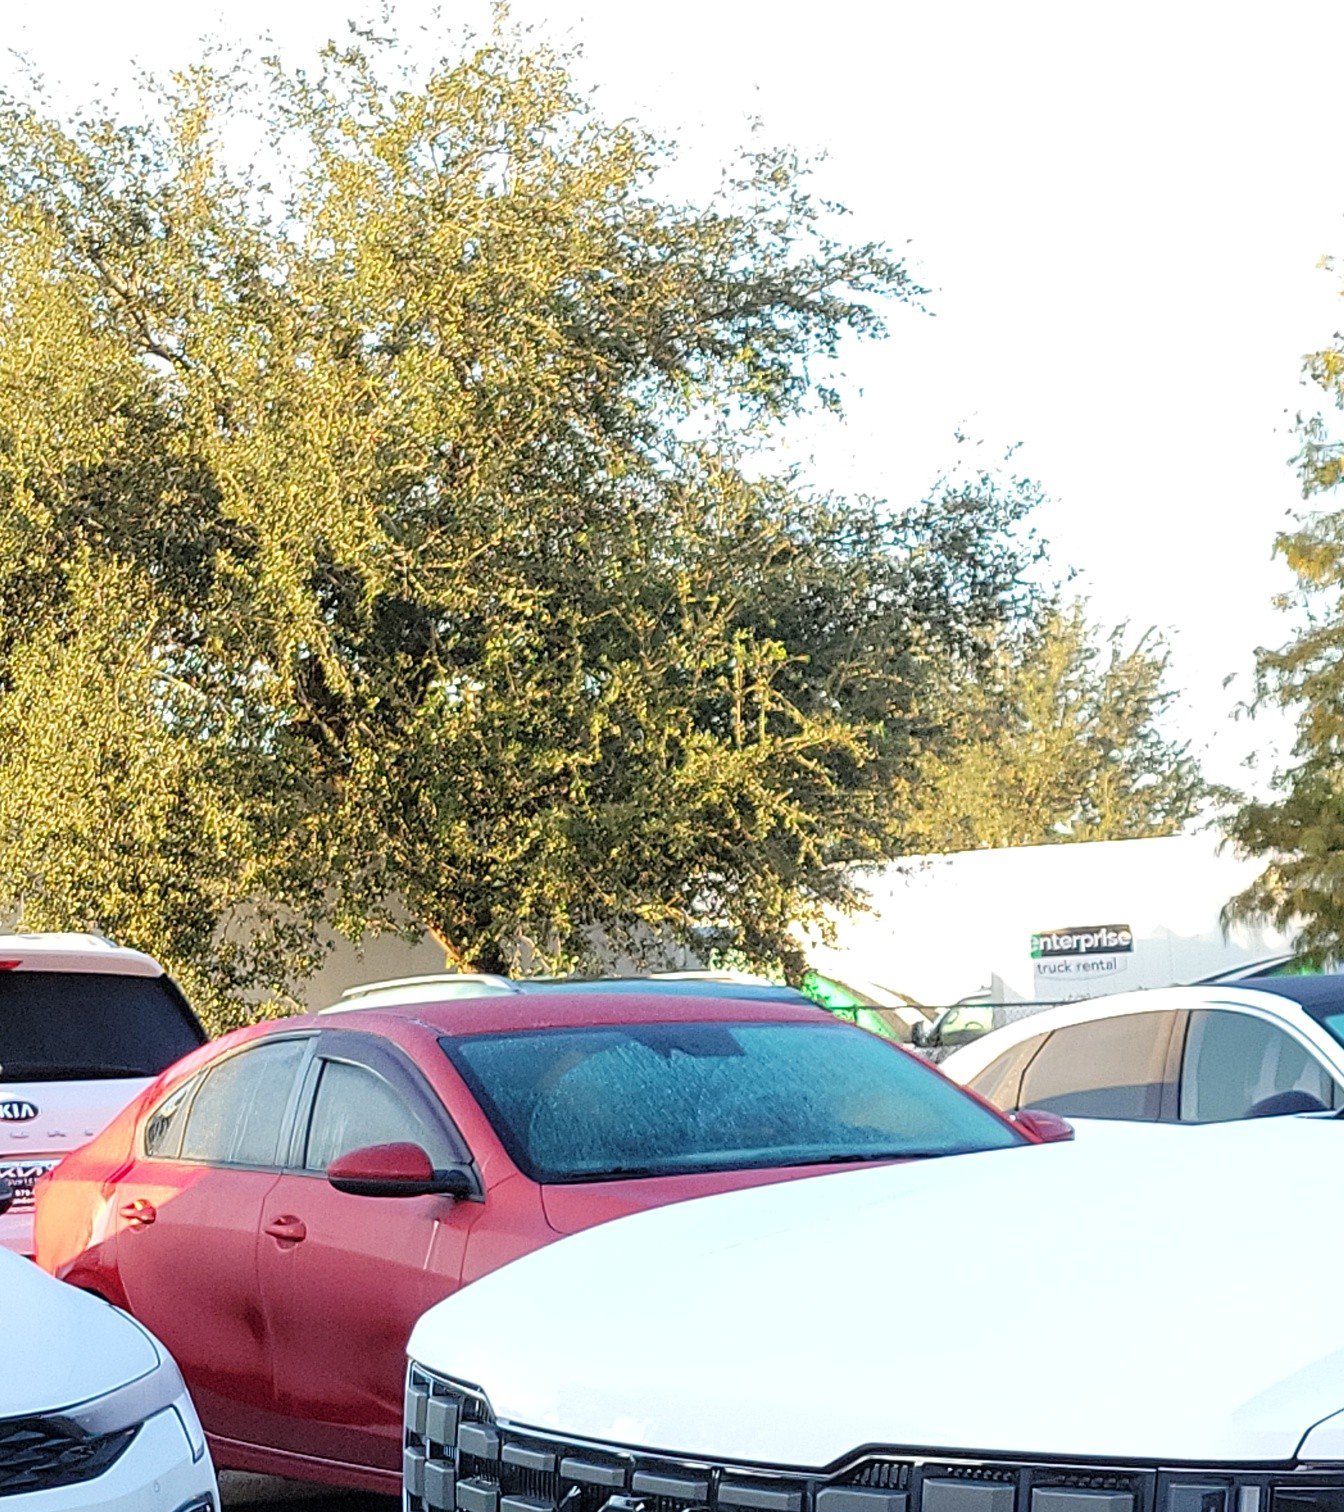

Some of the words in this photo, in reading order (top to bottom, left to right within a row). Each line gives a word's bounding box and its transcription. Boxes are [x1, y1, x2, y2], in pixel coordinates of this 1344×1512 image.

[1031, 928, 1131, 952] enterprise
[1037, 959, 1071, 974] truck
[1076, 957, 1117, 971] rental
[0, 1103, 35, 1119] KIA
